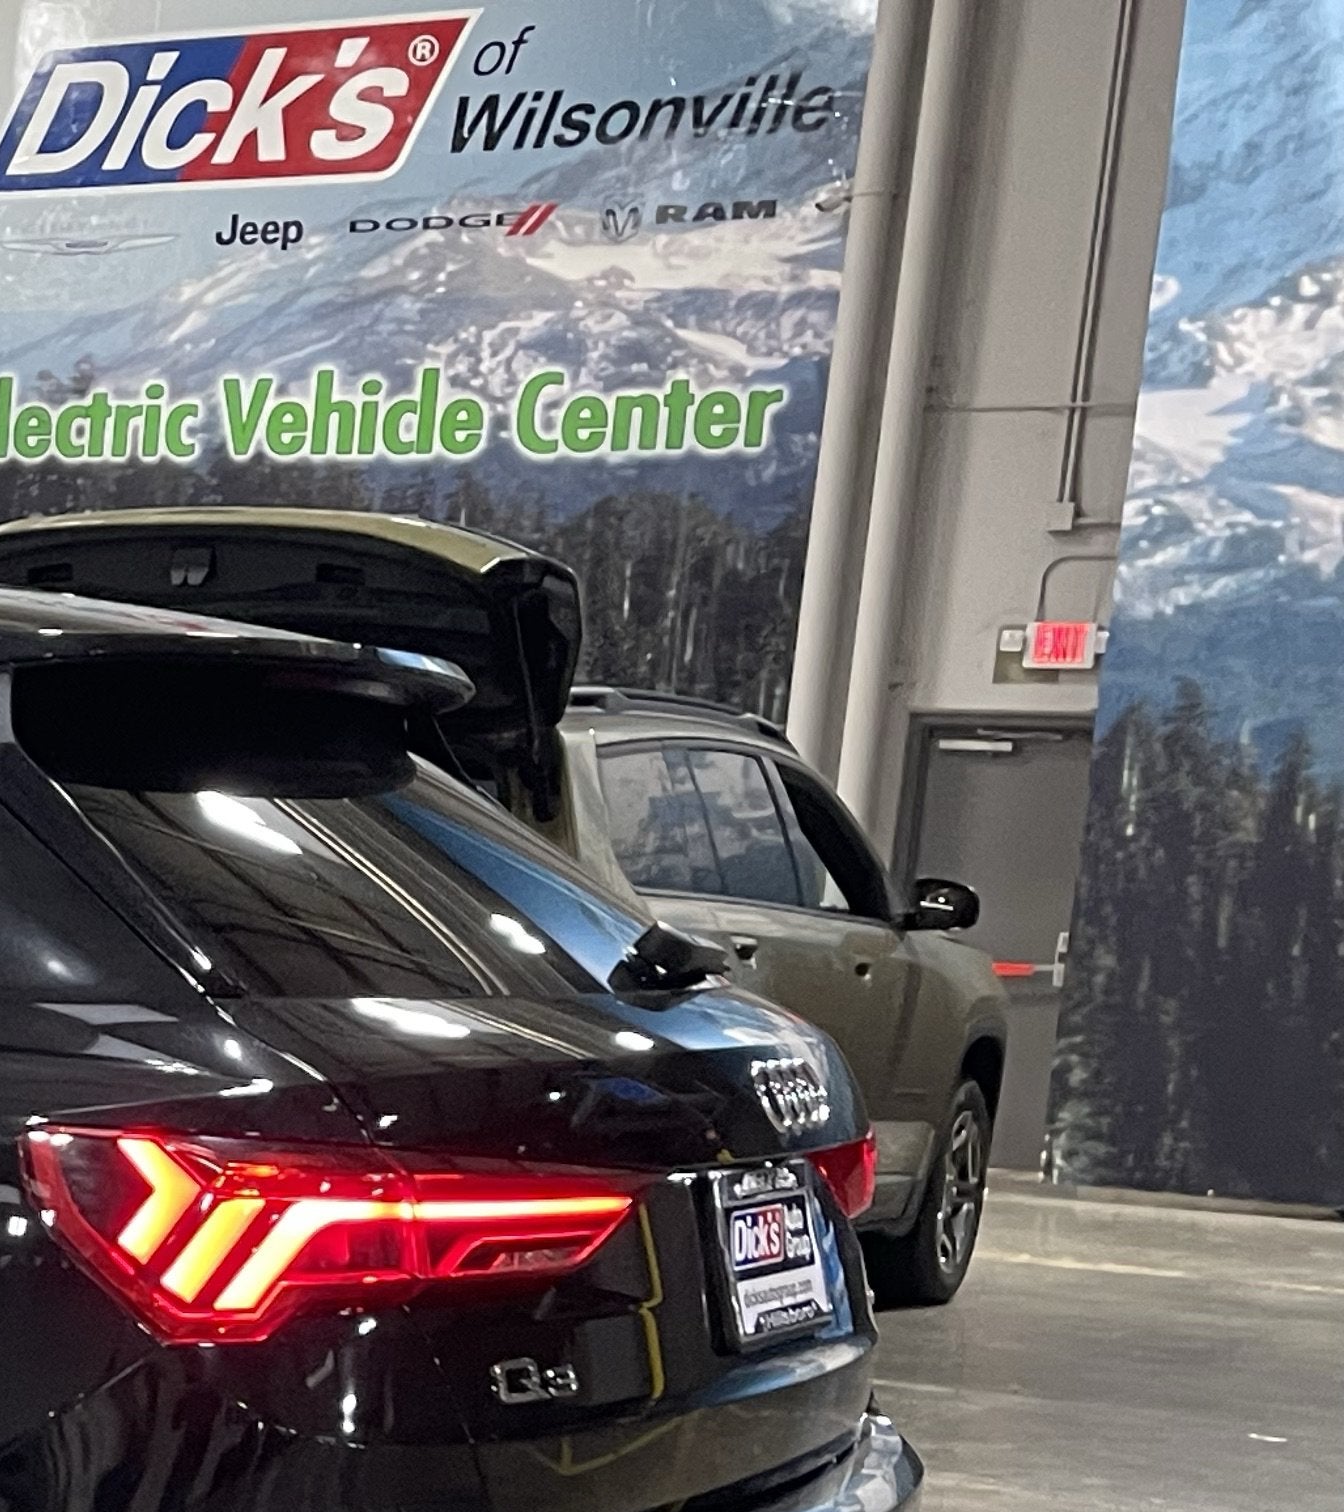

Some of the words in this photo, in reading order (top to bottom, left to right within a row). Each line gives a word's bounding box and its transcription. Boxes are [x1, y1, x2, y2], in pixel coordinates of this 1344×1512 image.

[473, 25, 535, 76] of
[450, 70, 835, 153] Wilsonville
[215, 214, 303, 251] Jeep
[349, 211, 518, 234] DODGE
[655, 200, 778, 224] RAM
[223, 367, 484, 456] Vehicle
[516, 371, 784, 454] Center
[1033, 624, 1087, 663] EXIT
[490, 1357, 578, 1404] Q3
